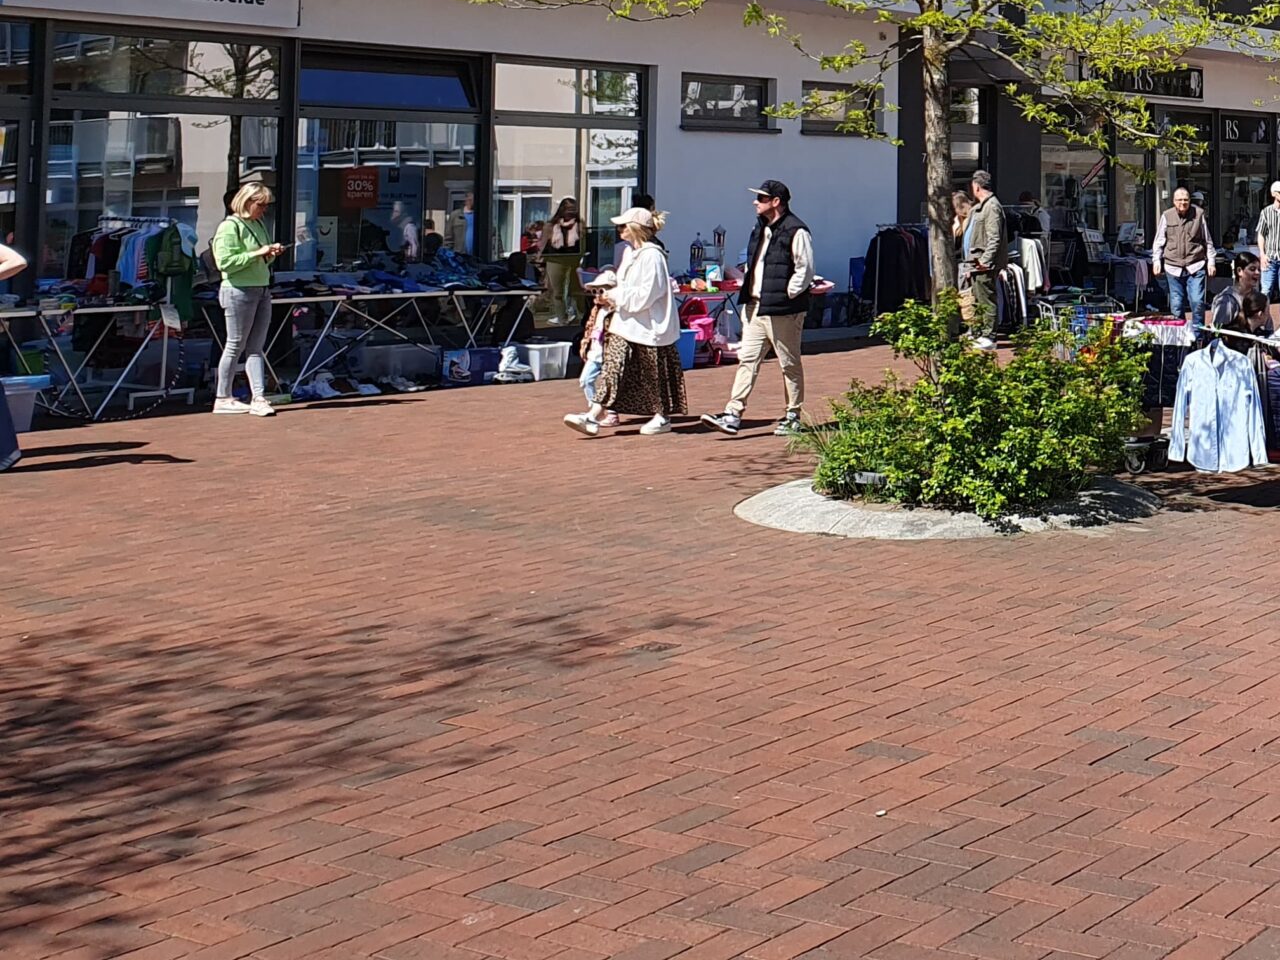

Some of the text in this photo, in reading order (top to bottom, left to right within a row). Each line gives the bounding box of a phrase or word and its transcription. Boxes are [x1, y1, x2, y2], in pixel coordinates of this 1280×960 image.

[1134, 69, 1154, 91] RS
[1225, 119, 1239, 140] RS
[347, 180, 374, 191] 30%
